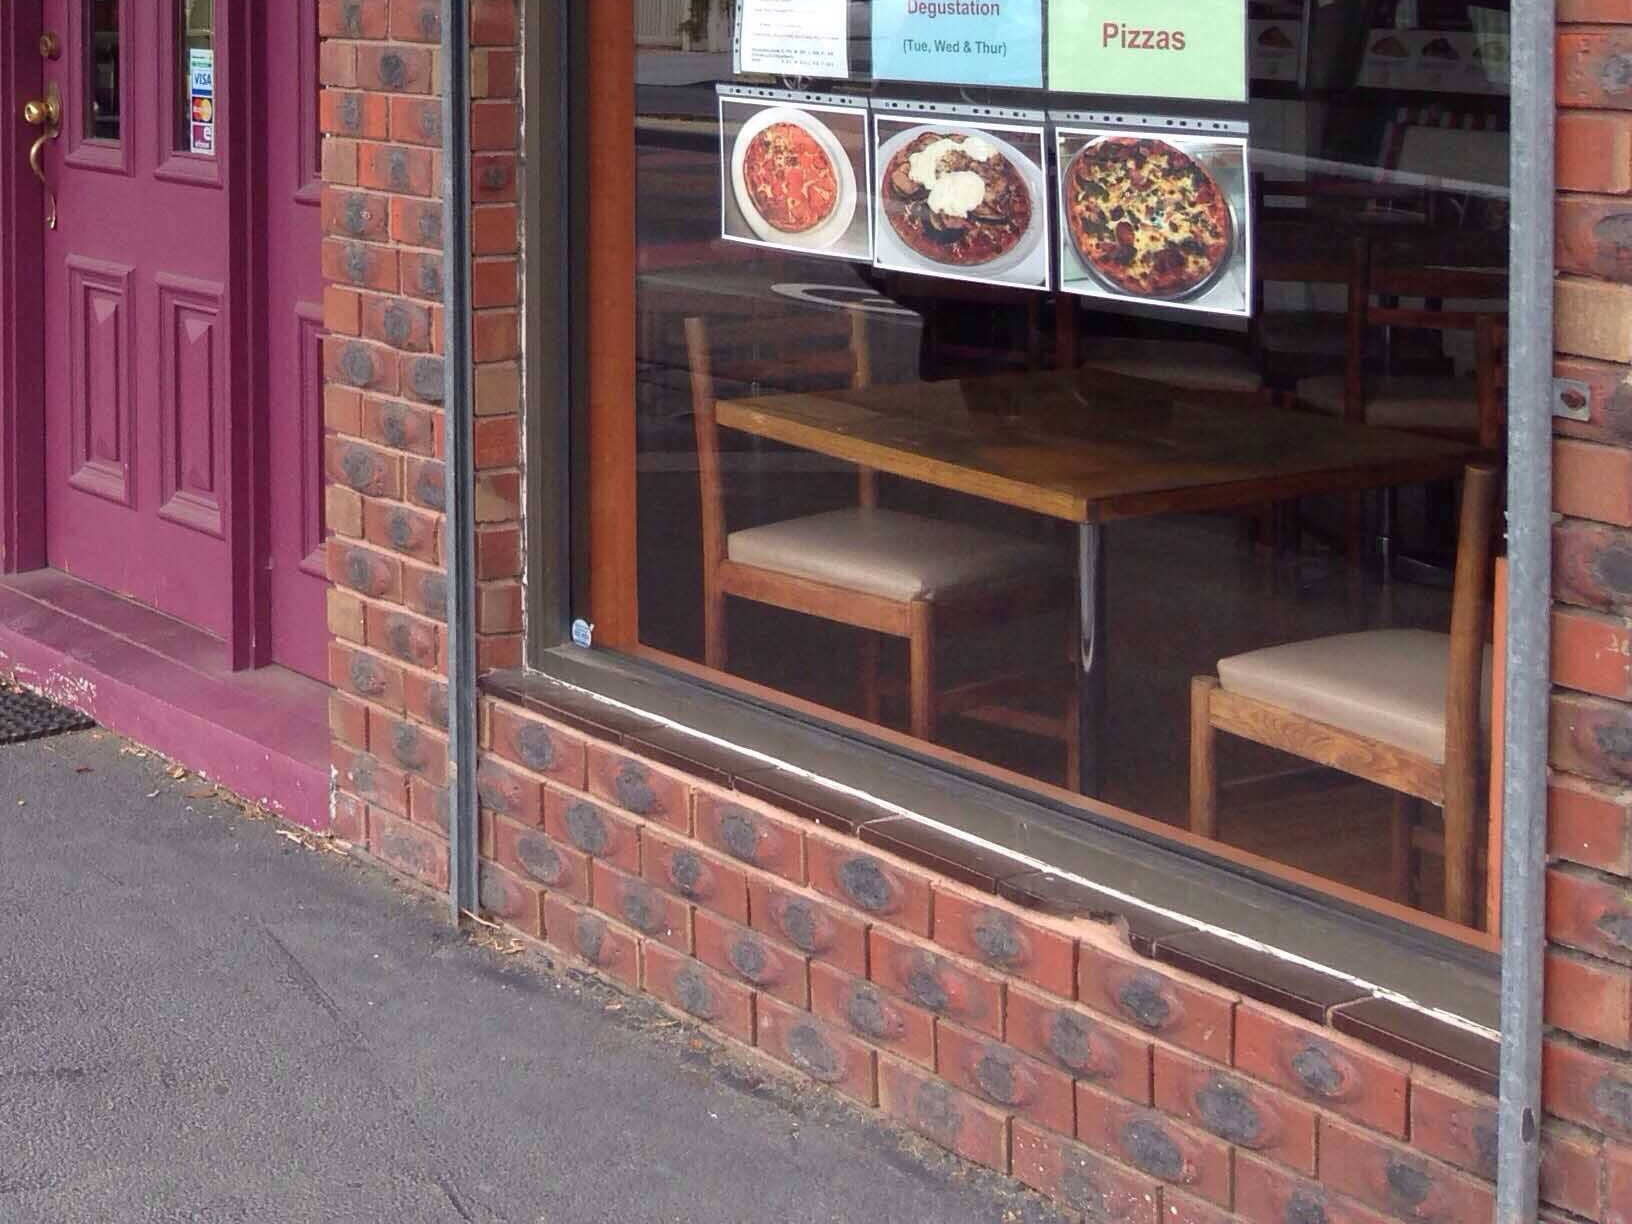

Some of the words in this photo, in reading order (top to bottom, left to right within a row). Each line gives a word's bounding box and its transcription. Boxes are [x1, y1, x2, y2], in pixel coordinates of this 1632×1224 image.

[903, 39, 931, 55] (Tue,
[934, 39, 960, 54] Wed
[963, 40, 972, 54] &
[974, 40, 1008, 57] Thur)
[1102, 22, 1187, 51] Pizzas
